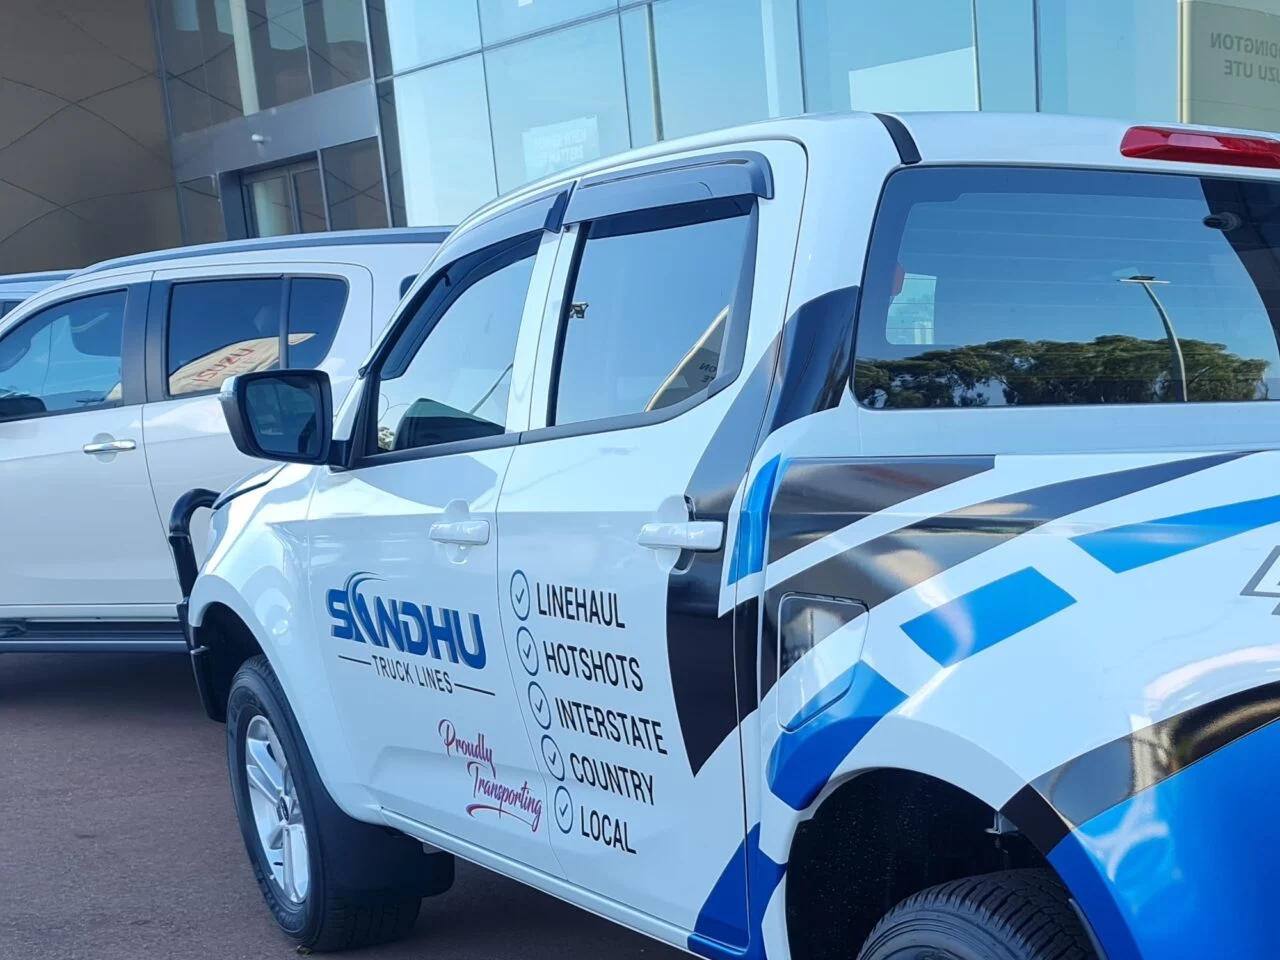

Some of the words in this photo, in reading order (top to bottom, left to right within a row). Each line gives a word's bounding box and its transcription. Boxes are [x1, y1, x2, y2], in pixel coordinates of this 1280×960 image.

[325, 572, 487, 669] SANDHU
[536, 582, 626, 629] LINEHAUL
[371, 655, 414, 683] TRUCK
[419, 666, 453, 694] LINES
[543, 640, 644, 692] HOTSHOTS
[438, 719, 497, 778] Proudly
[554, 697, 668, 755] INTERSTATE
[466, 761, 542, 830] Transporting
[569, 752, 655, 806] COUNTRY
[580, 805, 637, 855] LOCAL
